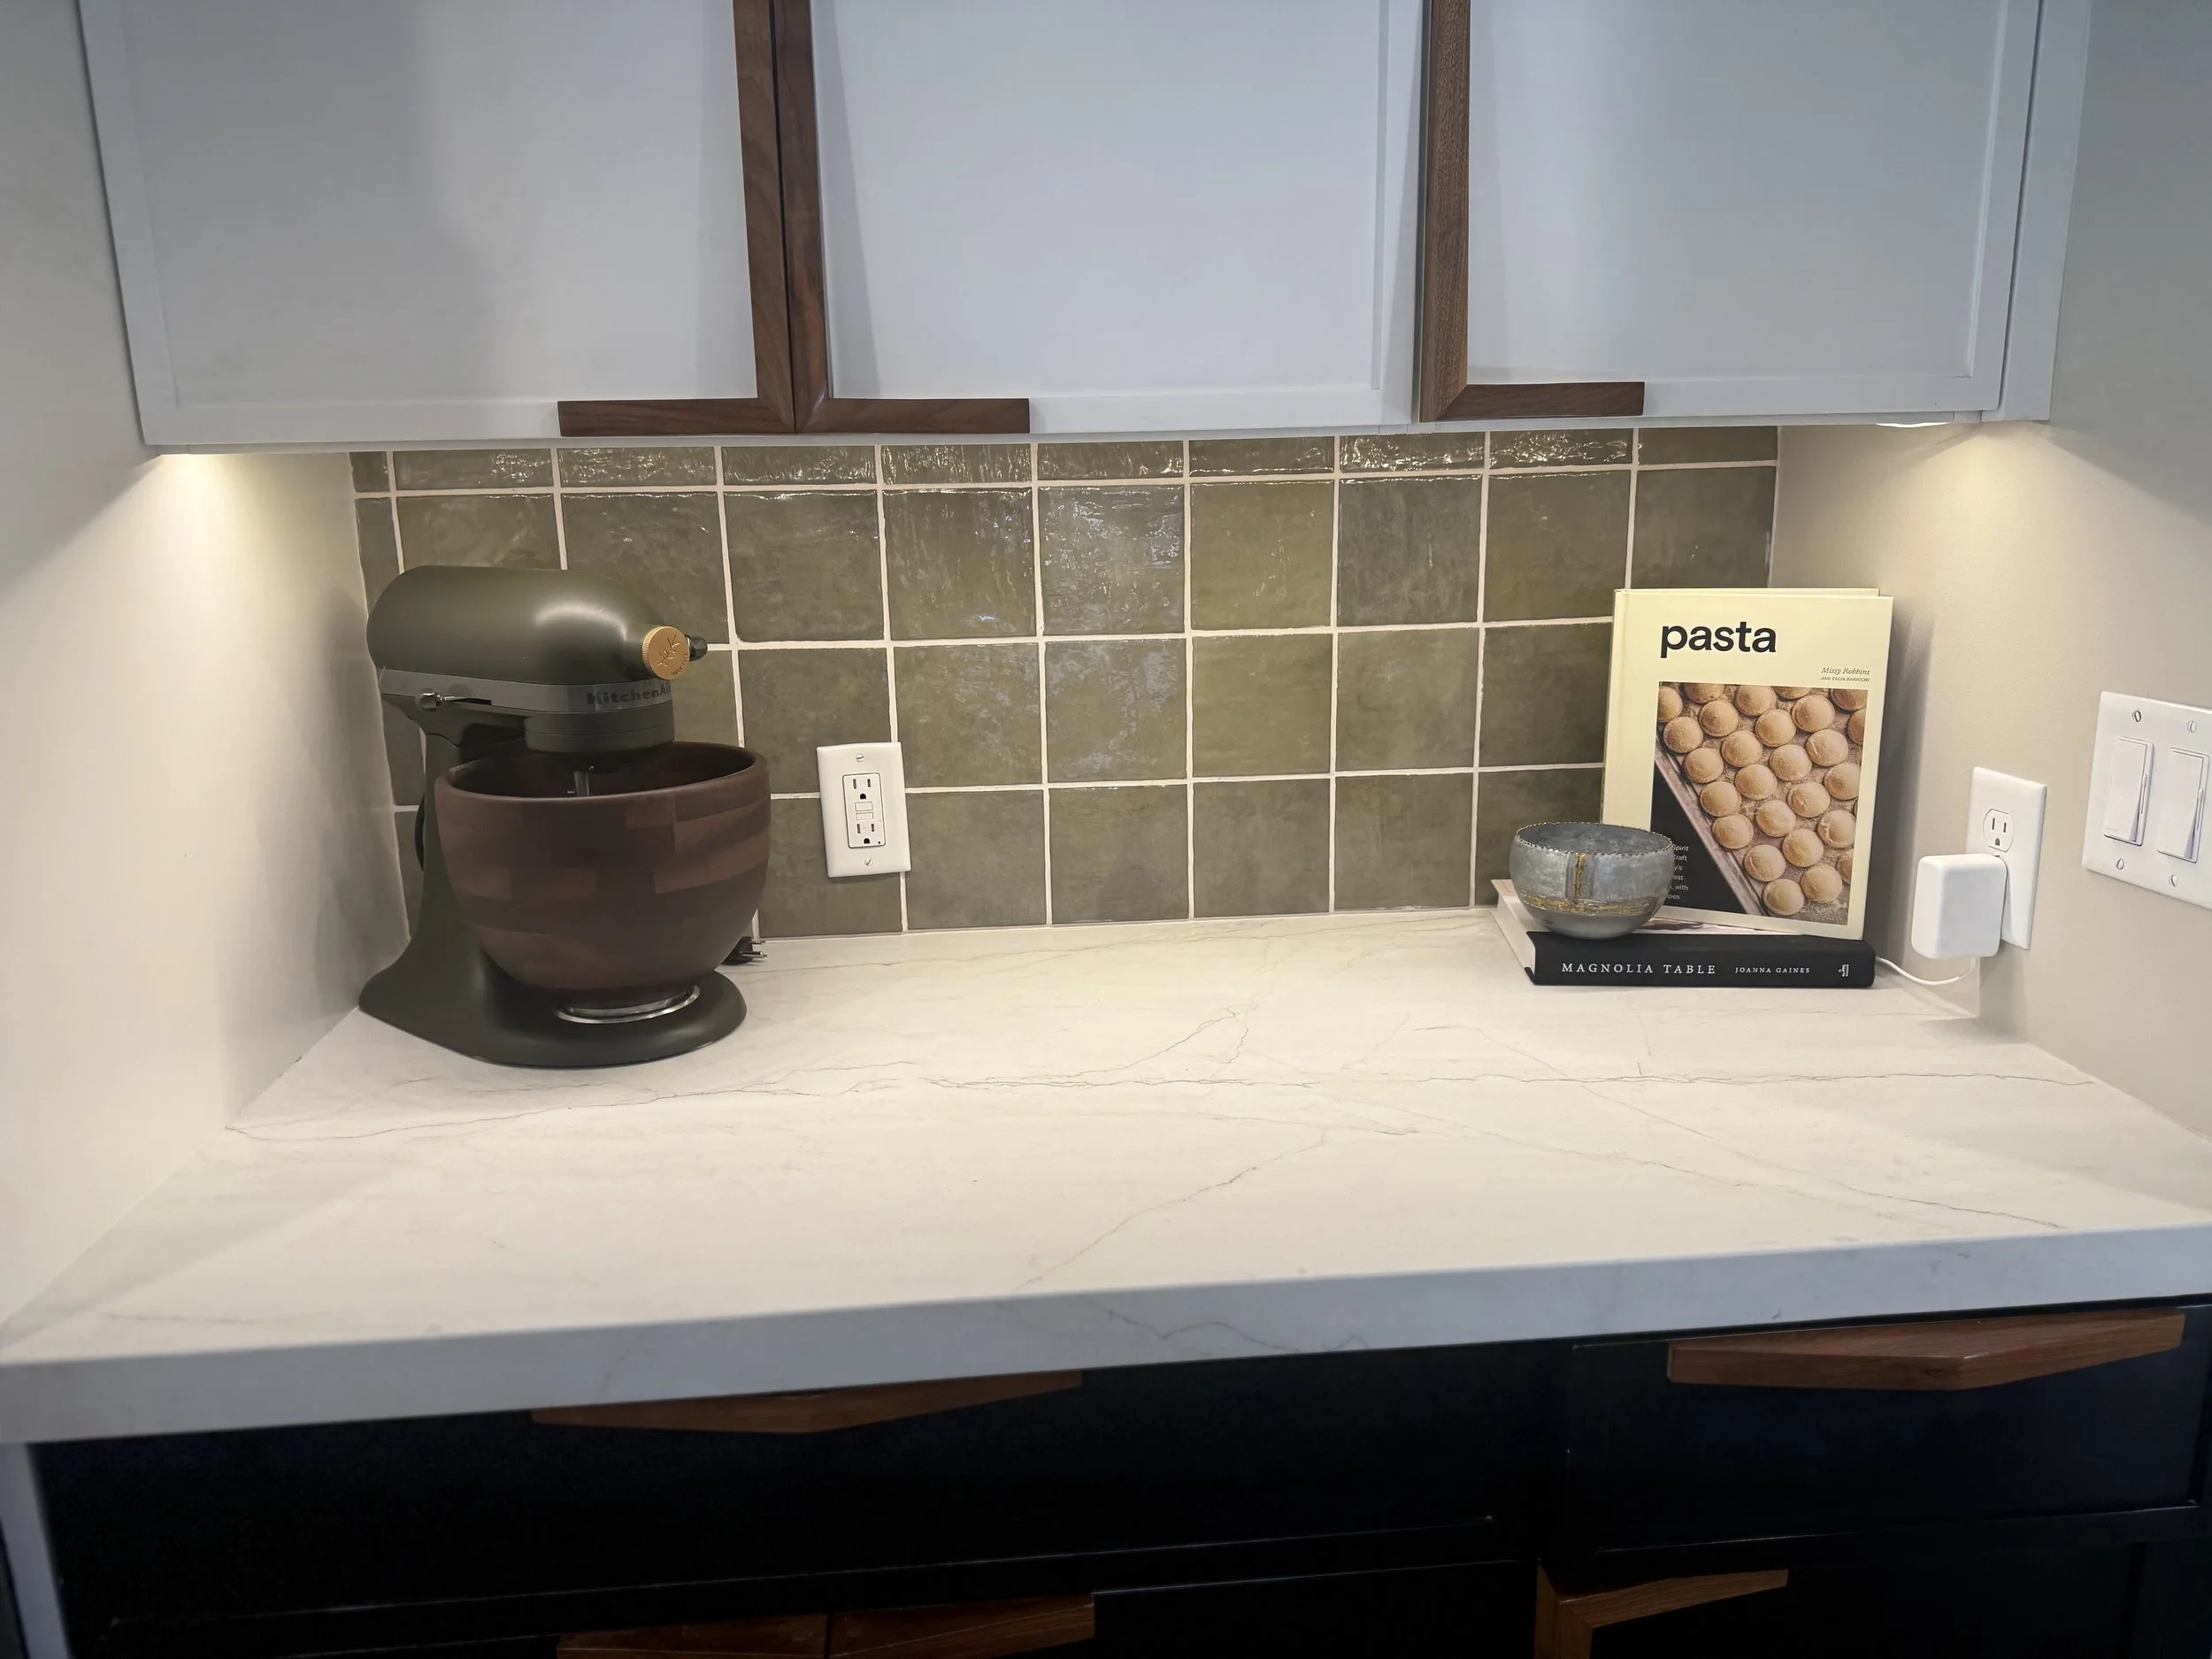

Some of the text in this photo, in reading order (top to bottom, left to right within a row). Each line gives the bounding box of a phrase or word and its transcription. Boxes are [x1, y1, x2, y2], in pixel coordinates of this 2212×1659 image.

[1660, 621, 1777, 658] pasta
[1562, 963, 1716, 974] MAGNOLIA TABLE
